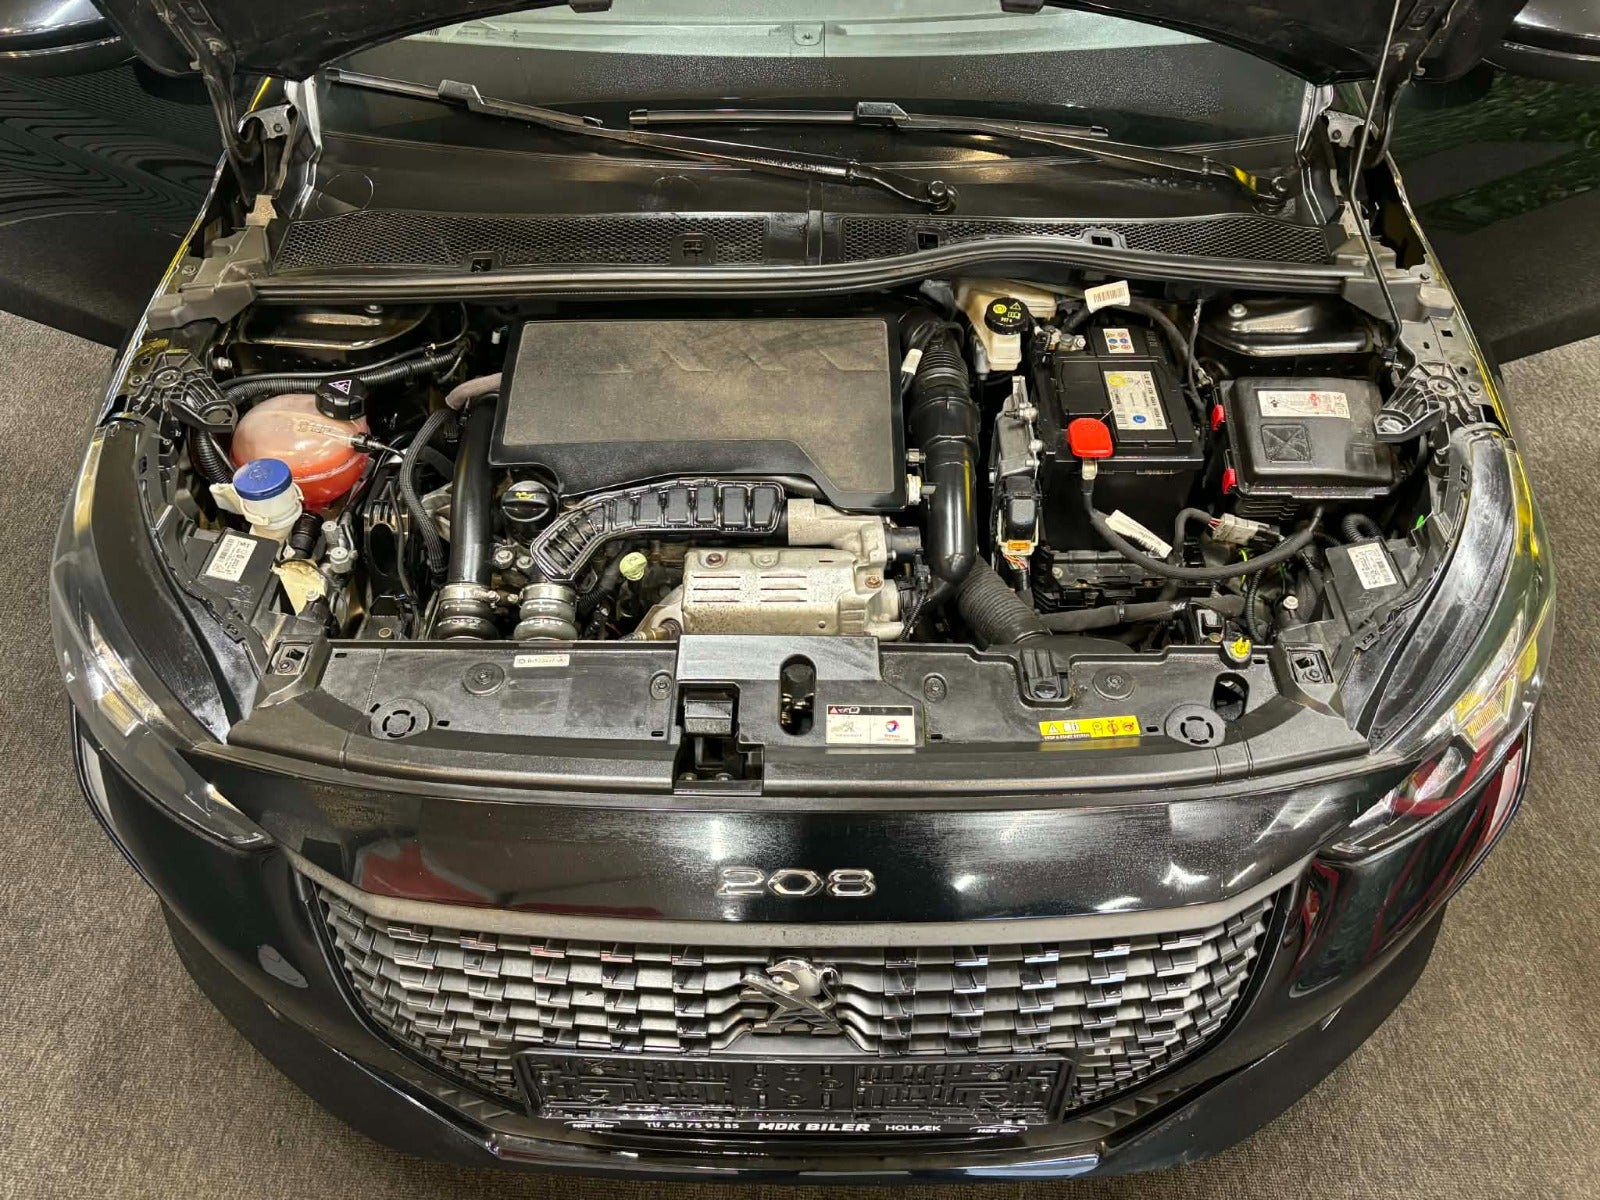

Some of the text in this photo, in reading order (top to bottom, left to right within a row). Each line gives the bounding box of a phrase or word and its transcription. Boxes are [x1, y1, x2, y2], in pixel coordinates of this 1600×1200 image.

[717, 867, 876, 897] 208
[758, 1122, 800, 1131] MDK
[804, 1122, 870, 1132] BILER
